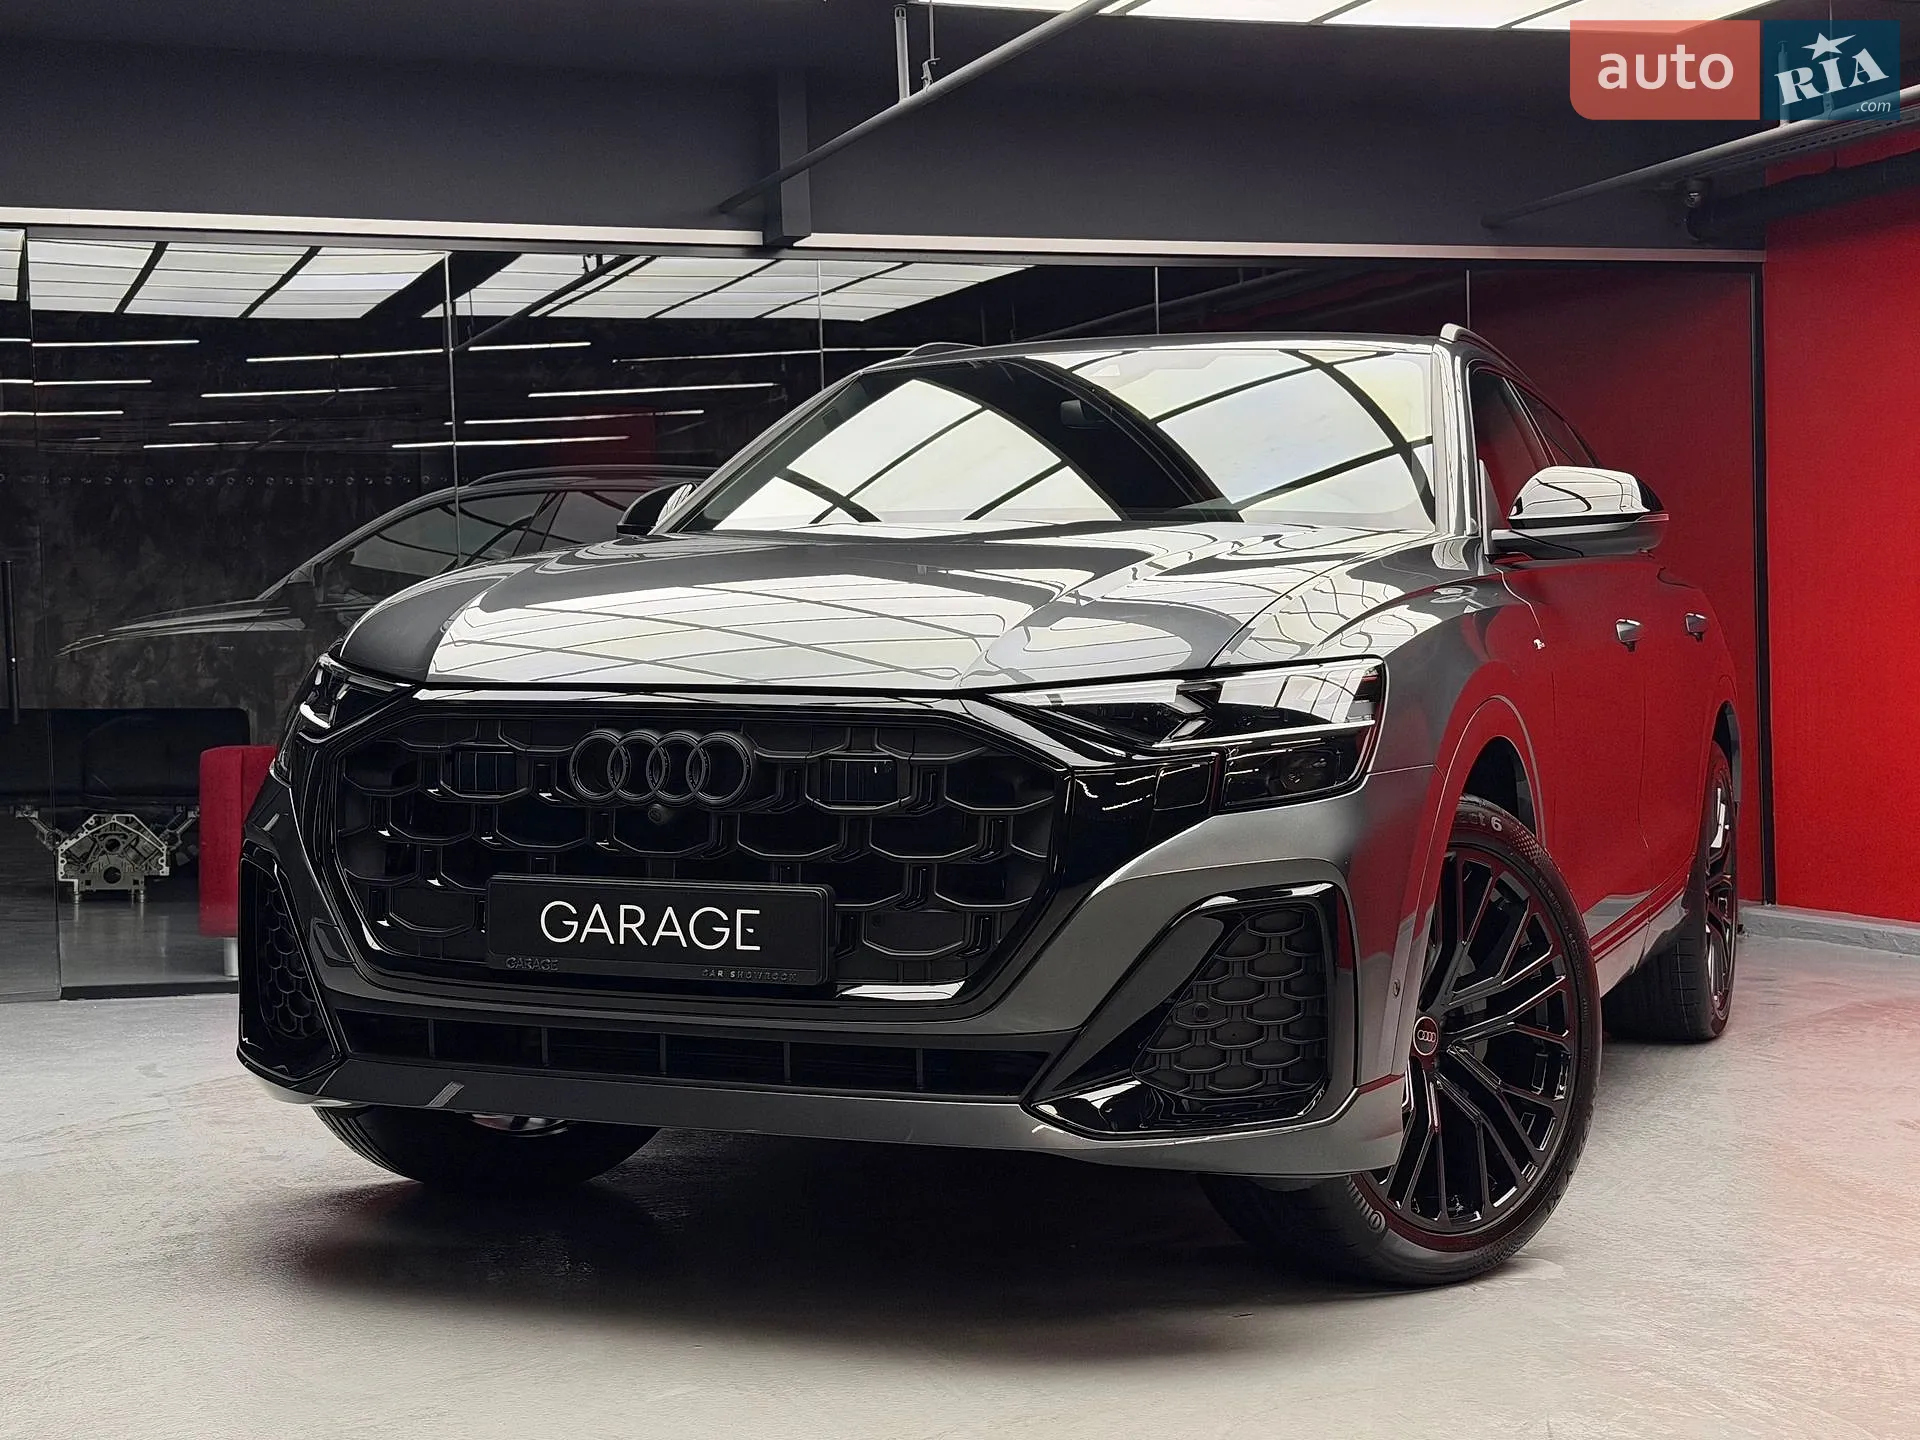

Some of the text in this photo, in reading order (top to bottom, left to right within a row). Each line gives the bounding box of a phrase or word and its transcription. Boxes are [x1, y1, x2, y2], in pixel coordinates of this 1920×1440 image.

[1490, 815, 1503, 832] 6
[539, 899, 761, 951] GARAGE
[505, 956, 559, 971] GARAGE
